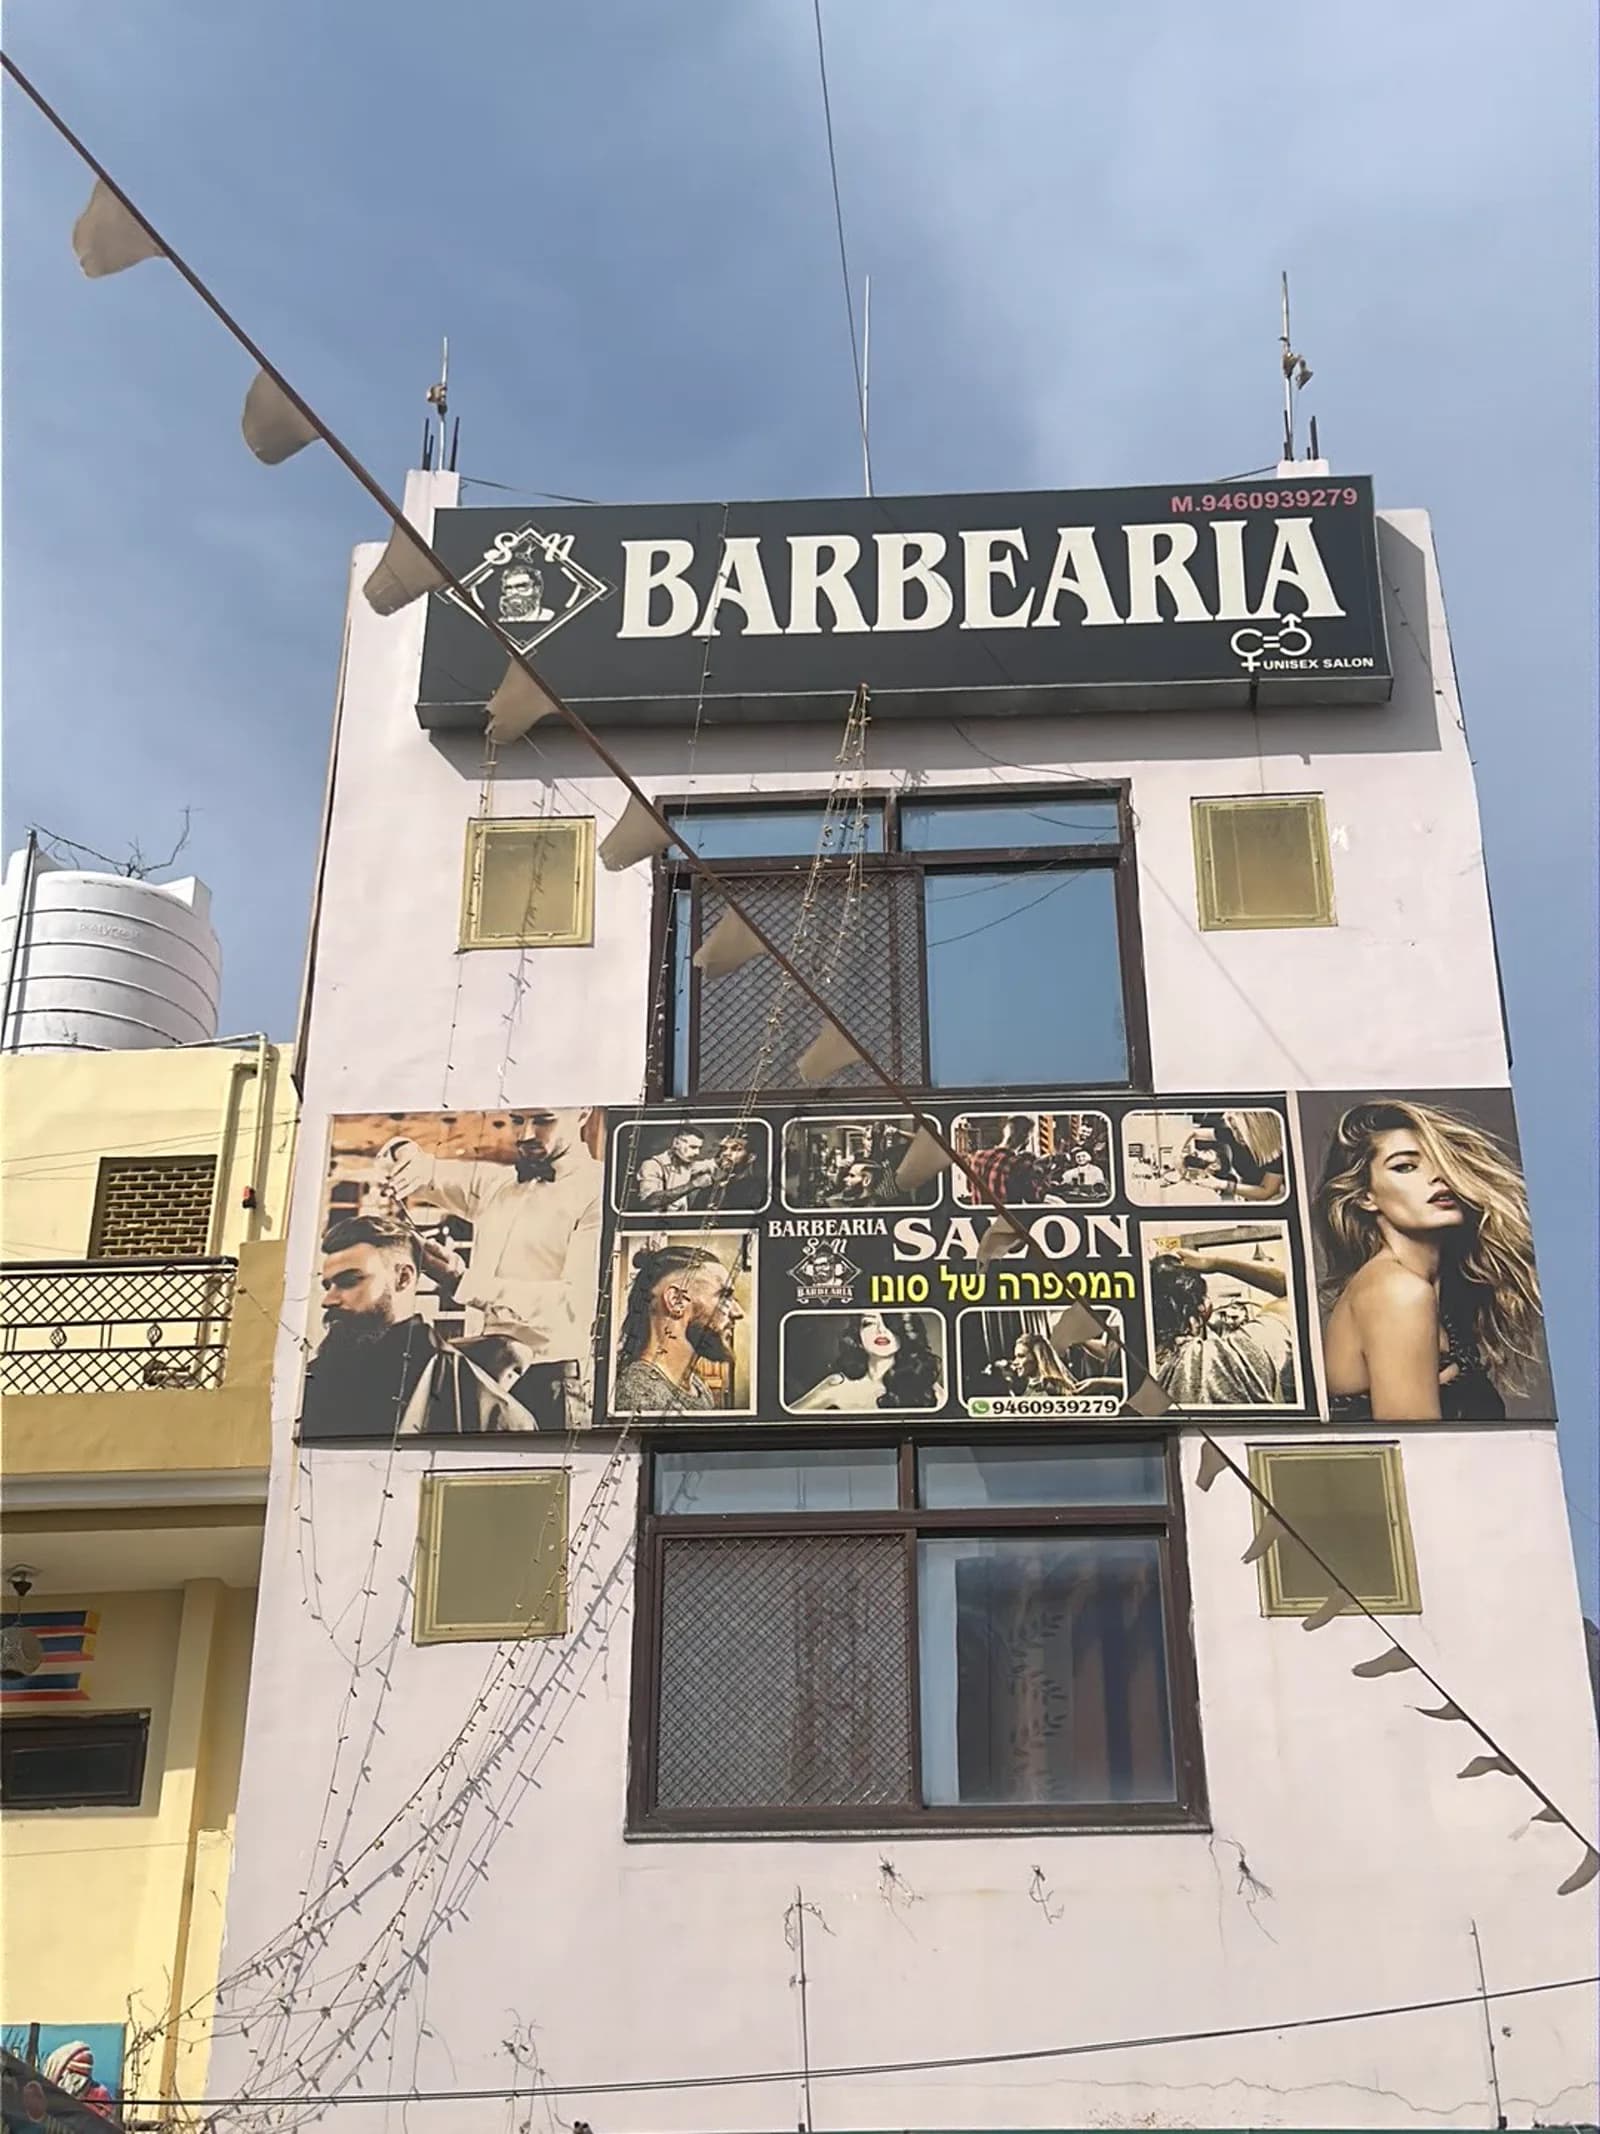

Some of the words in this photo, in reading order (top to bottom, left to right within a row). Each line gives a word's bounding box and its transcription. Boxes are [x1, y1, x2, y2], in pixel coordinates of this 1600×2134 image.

[1171, 488, 1358, 513] M.9460939279
[616, 517, 1347, 638] BARBEARIA
[1263, 659, 1319, 670] UNISEX
[1323, 657, 1374, 669] SALON
[768, 1218, 888, 1238] BARBEARIA
[871, 1275, 930, 1303] סונו
[940, 1265, 986, 1301] של
[992, 1400, 1116, 1414] 9460939279
